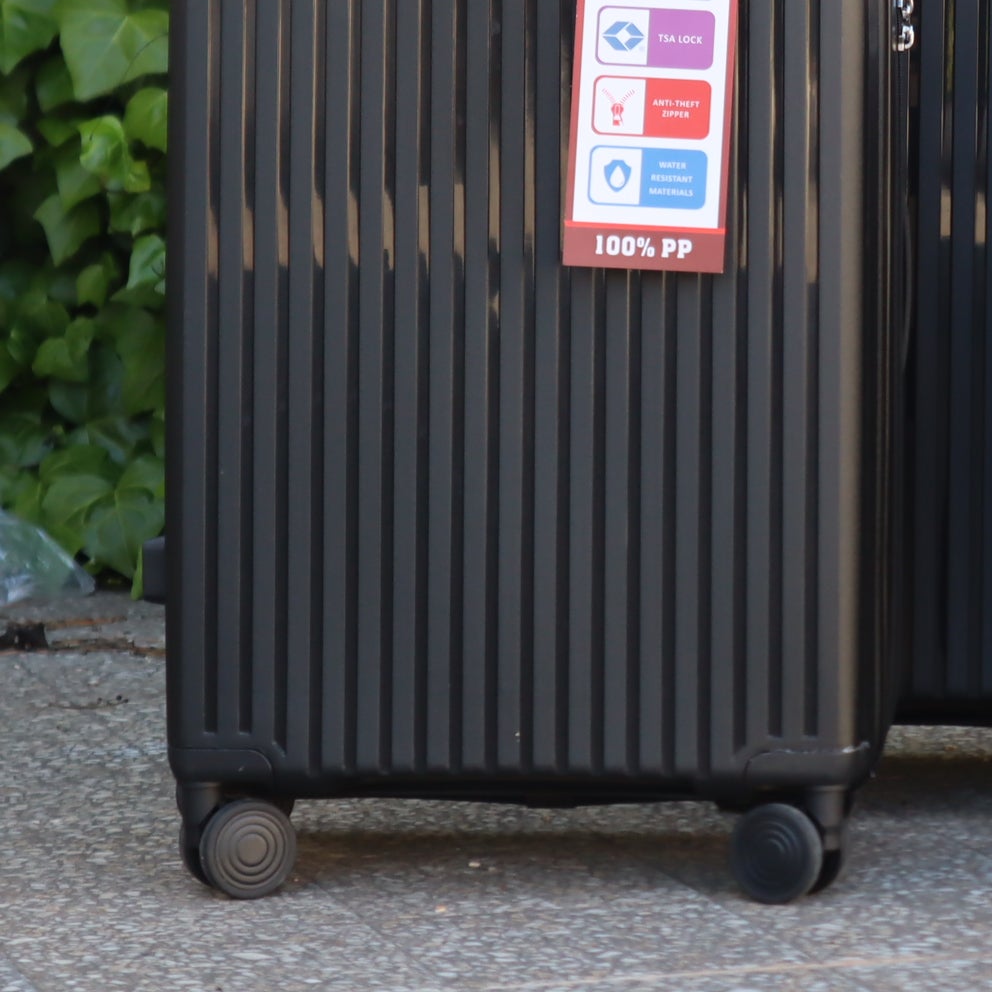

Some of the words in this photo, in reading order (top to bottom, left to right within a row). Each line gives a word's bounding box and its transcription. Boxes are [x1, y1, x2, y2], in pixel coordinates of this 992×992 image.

[658, 34, 676, 44] TSA
[678, 34, 702, 45] LOCK
[652, 99, 700, 108] ANTI-THEFT
[662, 110, 690, 119] ZIPPER
[658, 160, 686, 170] WATER
[650, 174, 693, 184] RESISTANT
[648, 187, 694, 197] MATERIALS
[595, 234, 655, 257] 100%
[661, 238, 693, 259] PP
